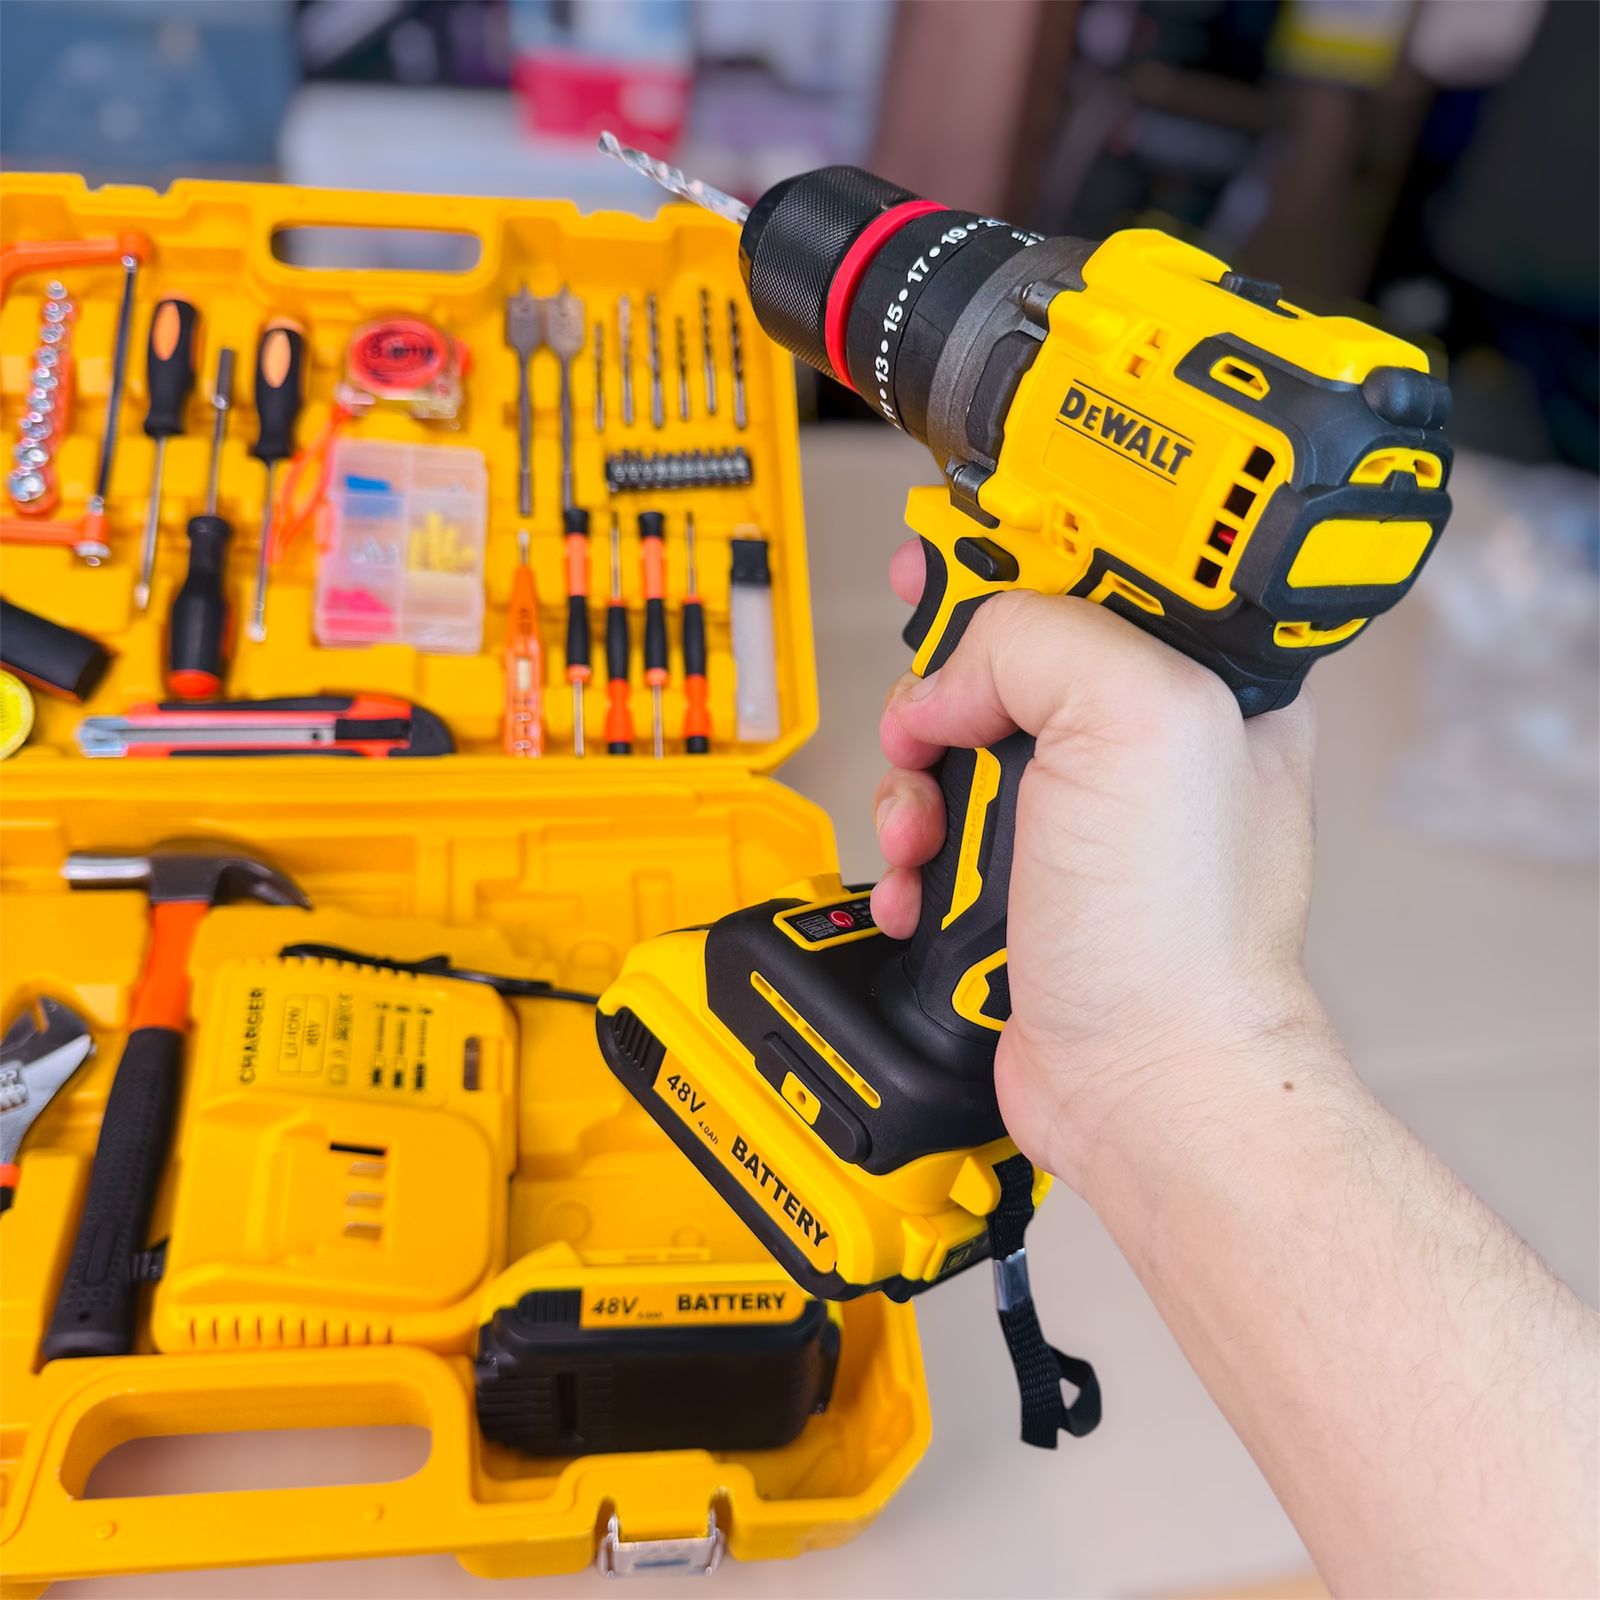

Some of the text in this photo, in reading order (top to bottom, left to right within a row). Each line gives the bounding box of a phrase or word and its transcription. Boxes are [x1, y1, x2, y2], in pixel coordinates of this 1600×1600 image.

[875, 356, 889, 383] 13
[883, 303, 903, 333] 15
[907, 256, 930, 283] 17
[941, 226, 968, 244] 19
[239, 987, 265, 1084] CHARGER
[667, 1074, 829, 1248] 48V 4.0Ah BATTERY
[592, 1292, 786, 1315] 48V BATTERY
